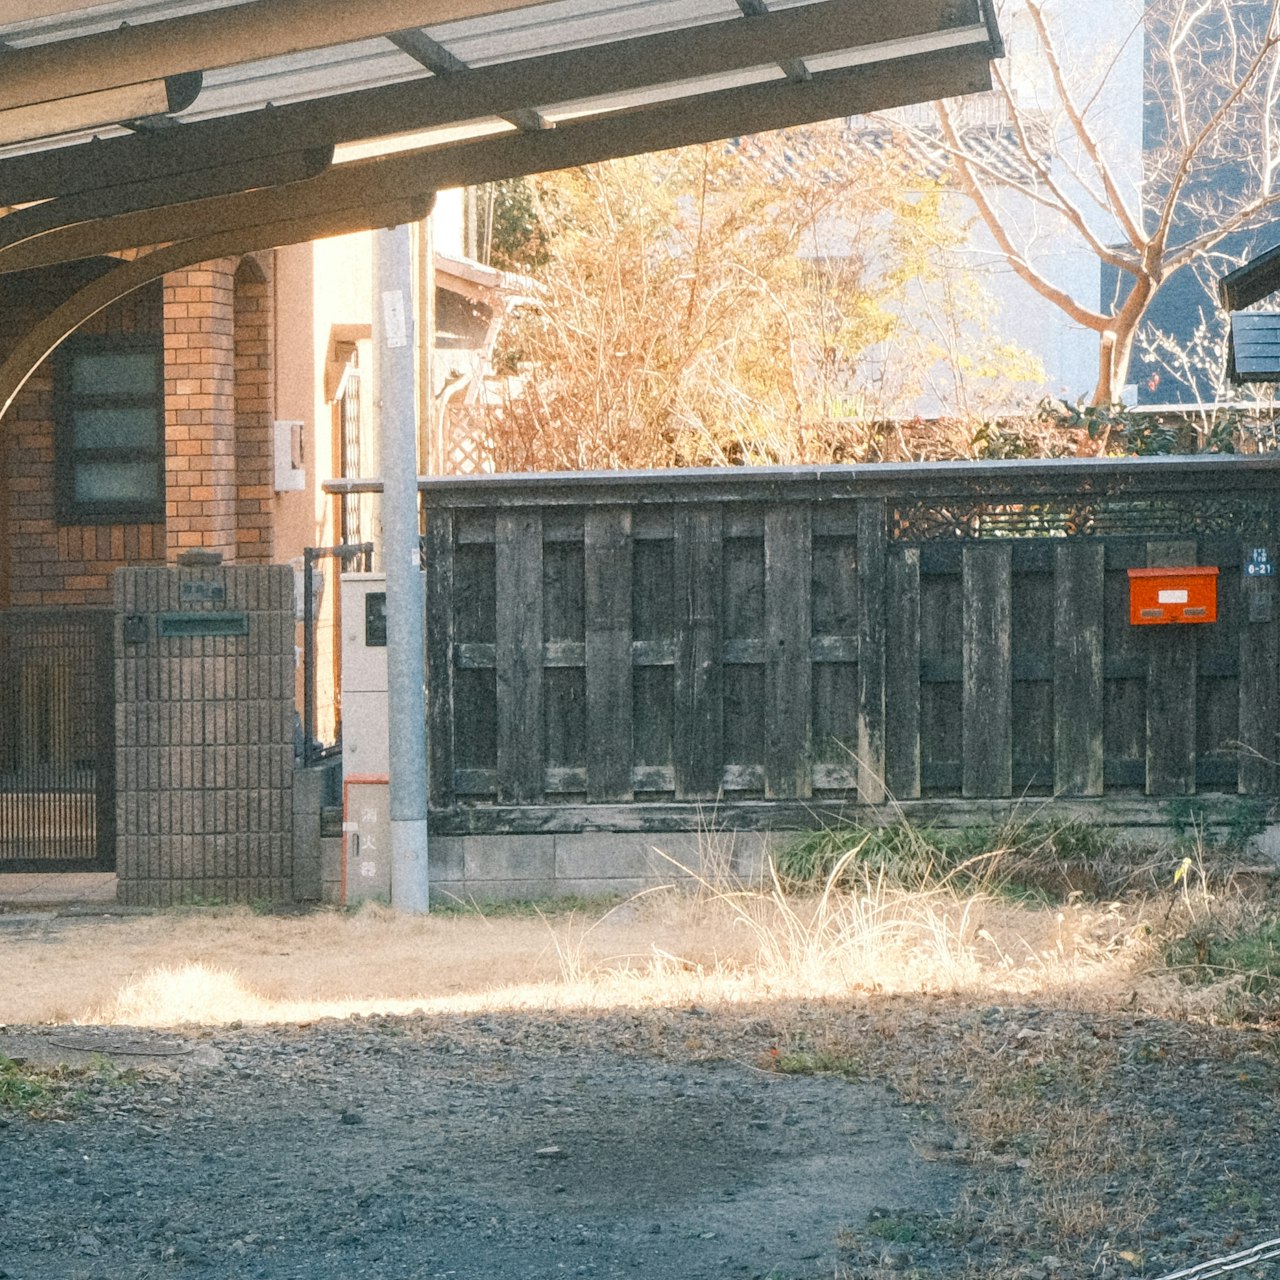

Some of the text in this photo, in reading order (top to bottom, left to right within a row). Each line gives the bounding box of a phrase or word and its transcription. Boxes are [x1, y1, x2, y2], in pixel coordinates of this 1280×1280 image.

[1248, 564, 1271, 574] 6-21
[361, 807, 377, 877] 消火器
